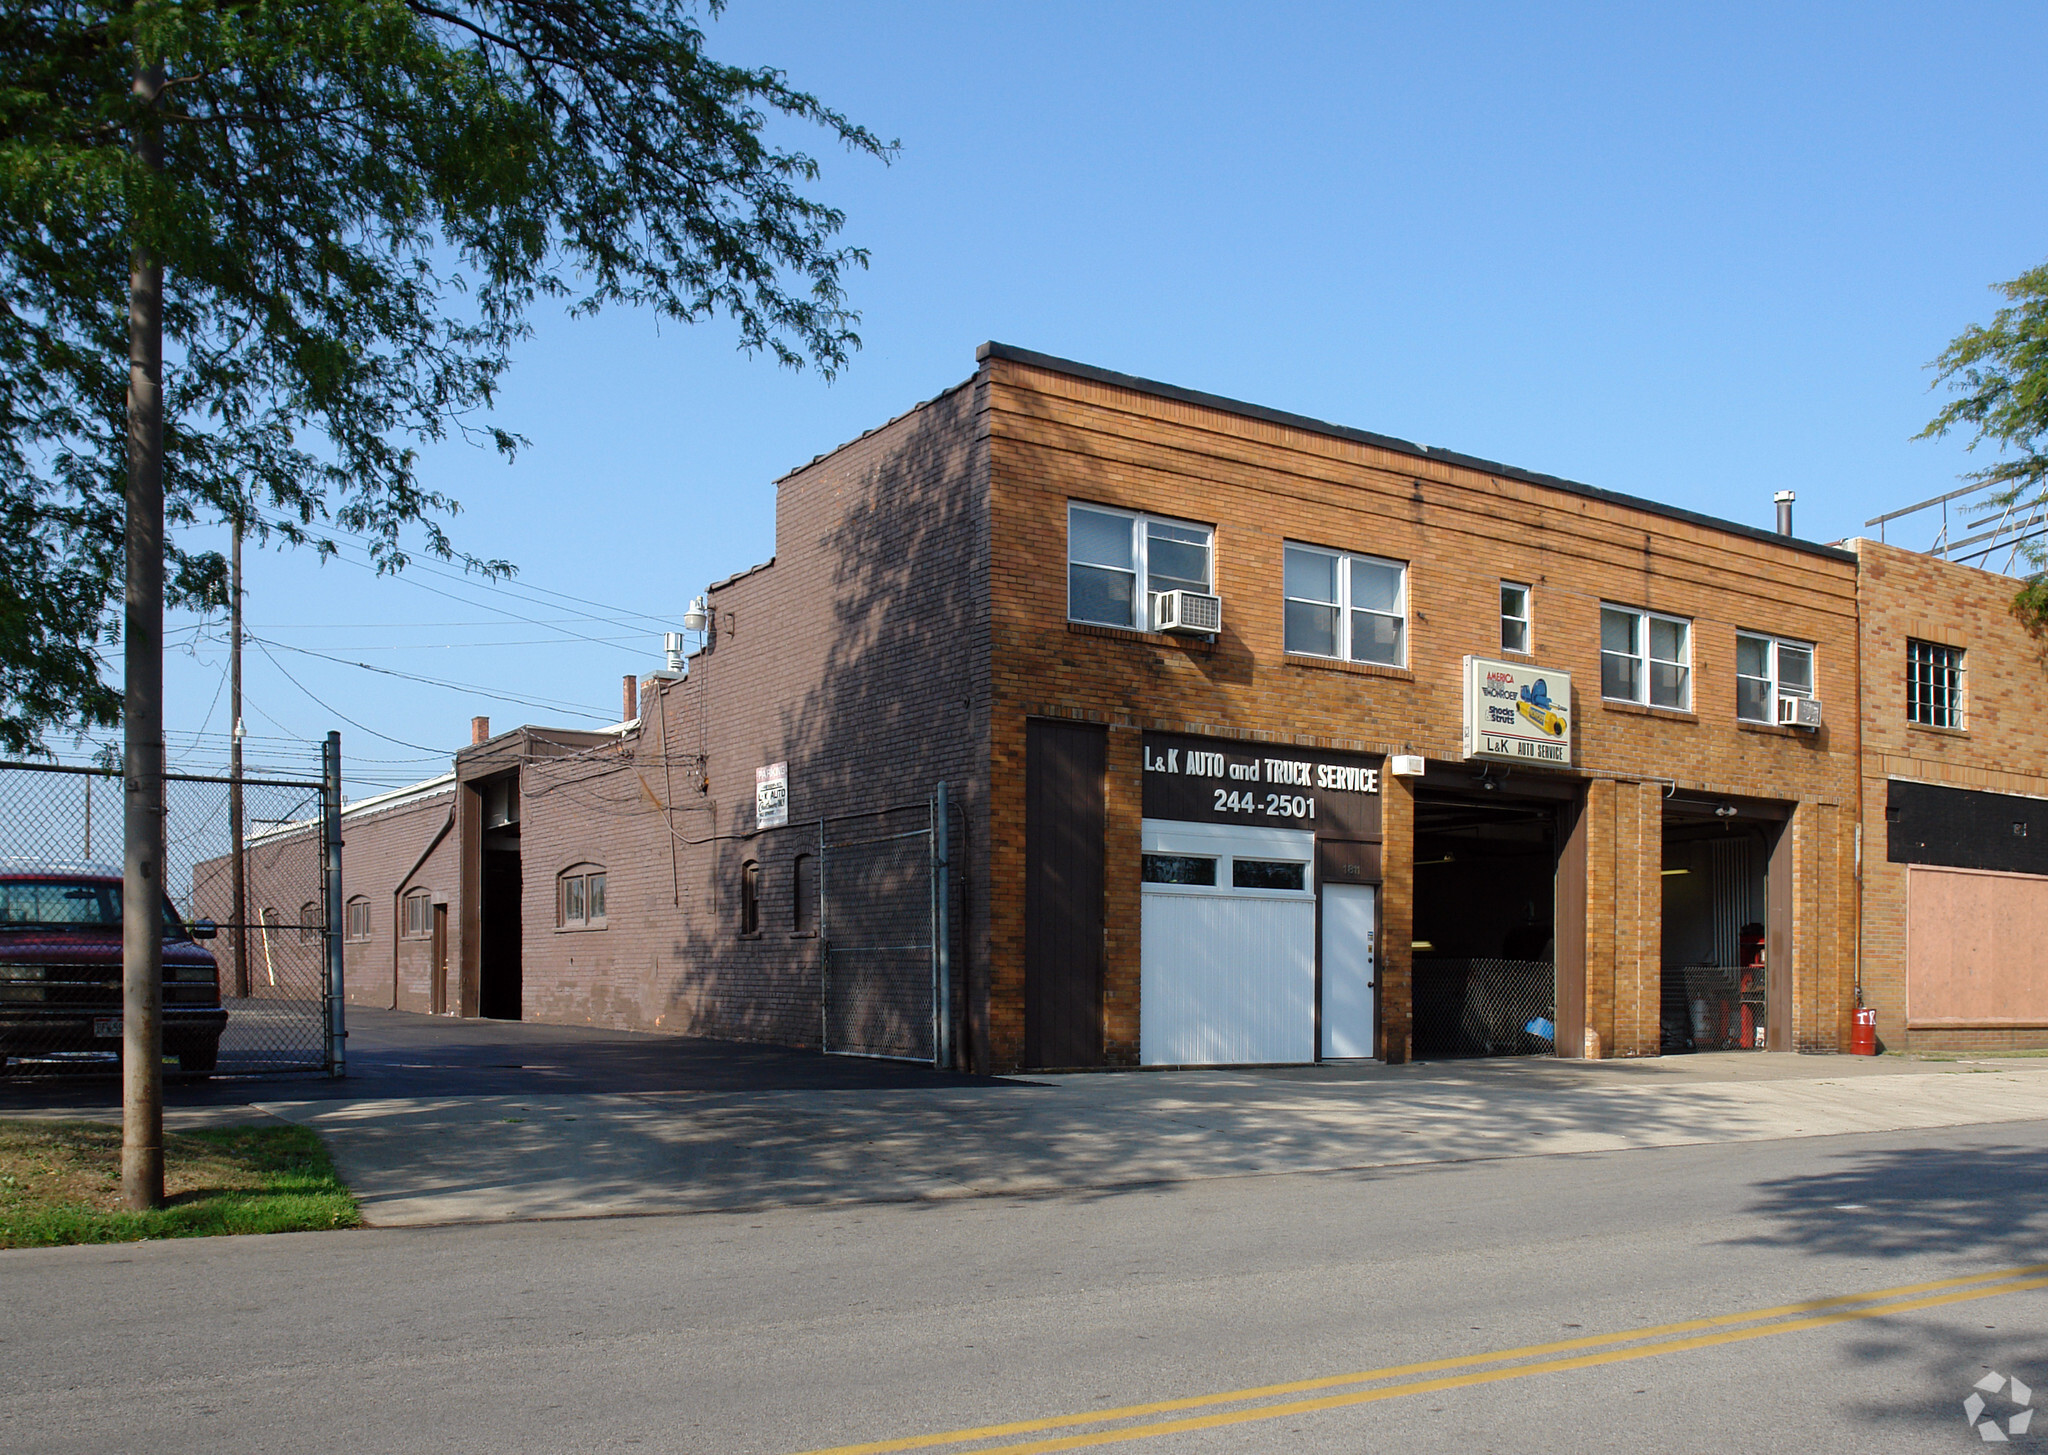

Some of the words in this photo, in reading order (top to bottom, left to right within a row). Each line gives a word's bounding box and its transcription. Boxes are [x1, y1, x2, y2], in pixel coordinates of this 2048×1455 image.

[1487, 672, 1514, 683] AMERICA
[1482, 687, 1518, 700] MONROE
[1489, 706, 1514, 717] Shocks
[1491, 714, 1515, 725] Struts
[1487, 737, 1509, 753] L&K
[1518, 742, 1535, 757] AUTO
[1538, 744, 1563, 760] SERVICE
[759, 766, 785, 779] PARKING
[1144, 746, 1179, 774] L&K
[1185, 751, 1224, 778] AUTO
[1229, 759, 1260, 782] and
[1264, 758, 1313, 787] TRUCK
[1317, 764, 1379, 793] SERVICE
[771, 789, 785, 798] AUTO
[1213, 789, 1316, 819] 244-2501
[1342, 863, 1361, 875] 1811
